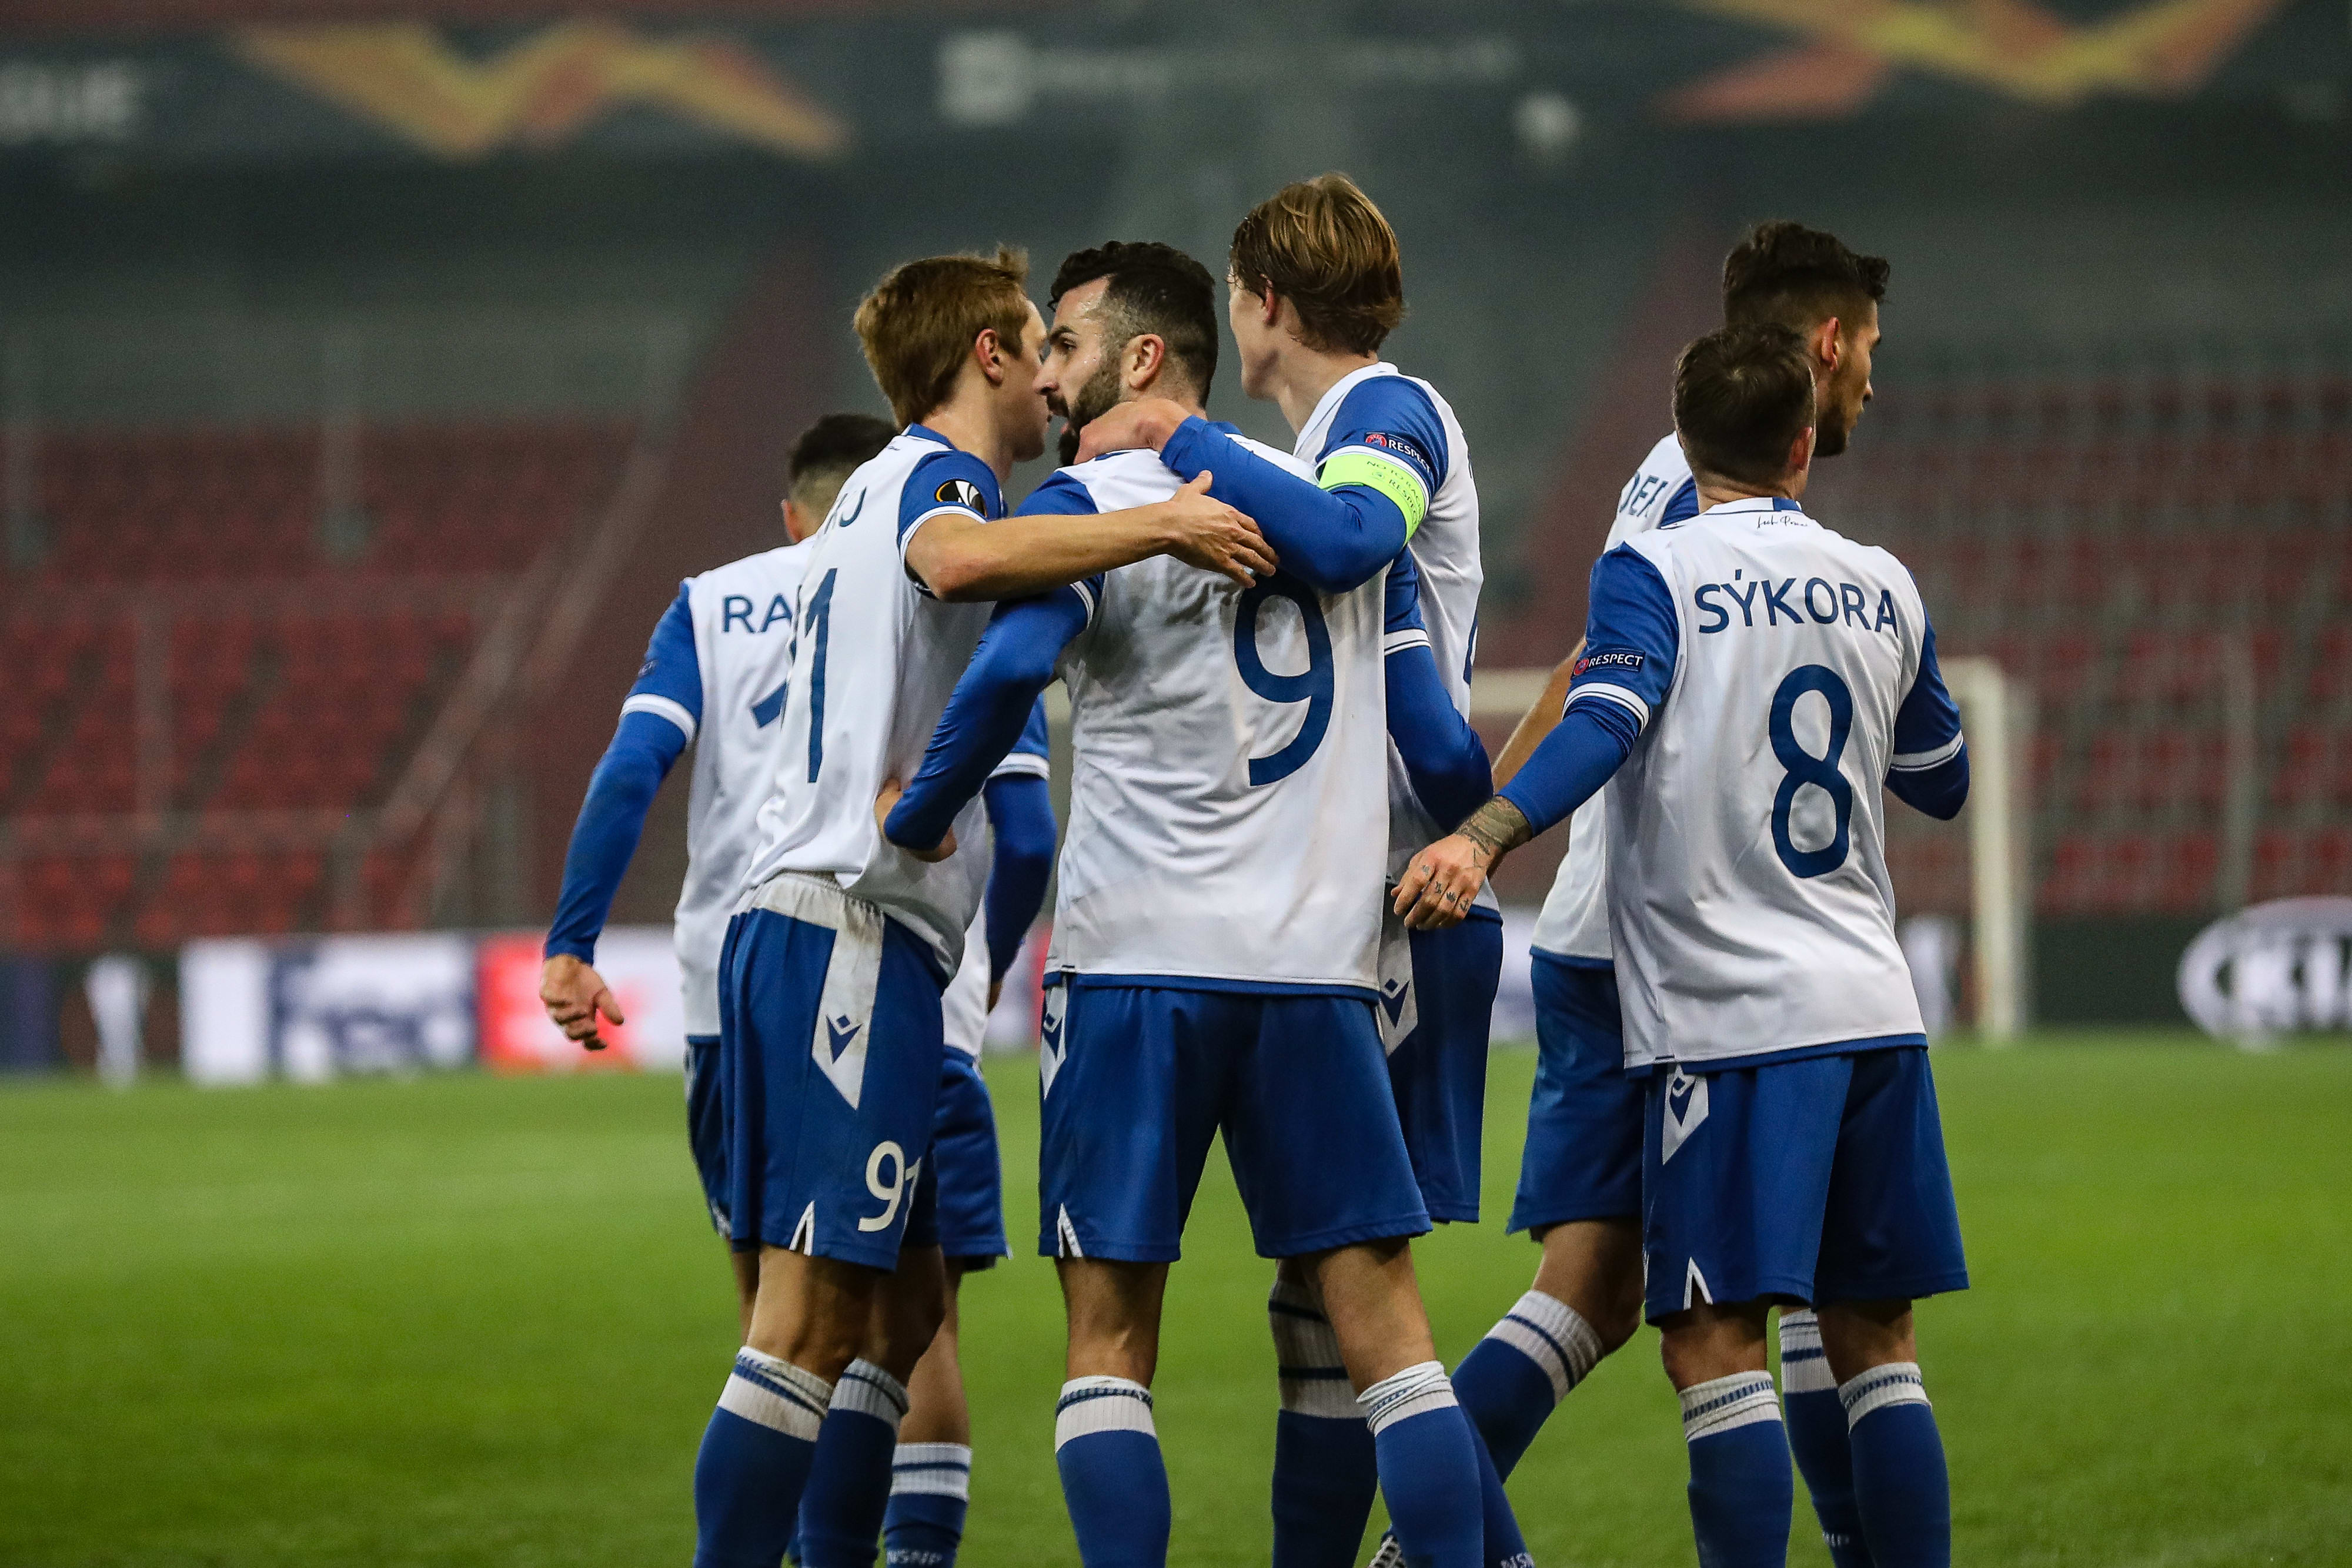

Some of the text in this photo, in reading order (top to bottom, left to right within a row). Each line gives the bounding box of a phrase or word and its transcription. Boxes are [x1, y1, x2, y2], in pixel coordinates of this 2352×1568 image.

[1388, 439, 1431, 473] RESPECT
[1694, 569, 1898, 637] SÝKORA
[1235, 575, 1334, 786] 9
[1588, 654, 1643, 668] RESPECT
[1769, 664, 1853, 878] 8
